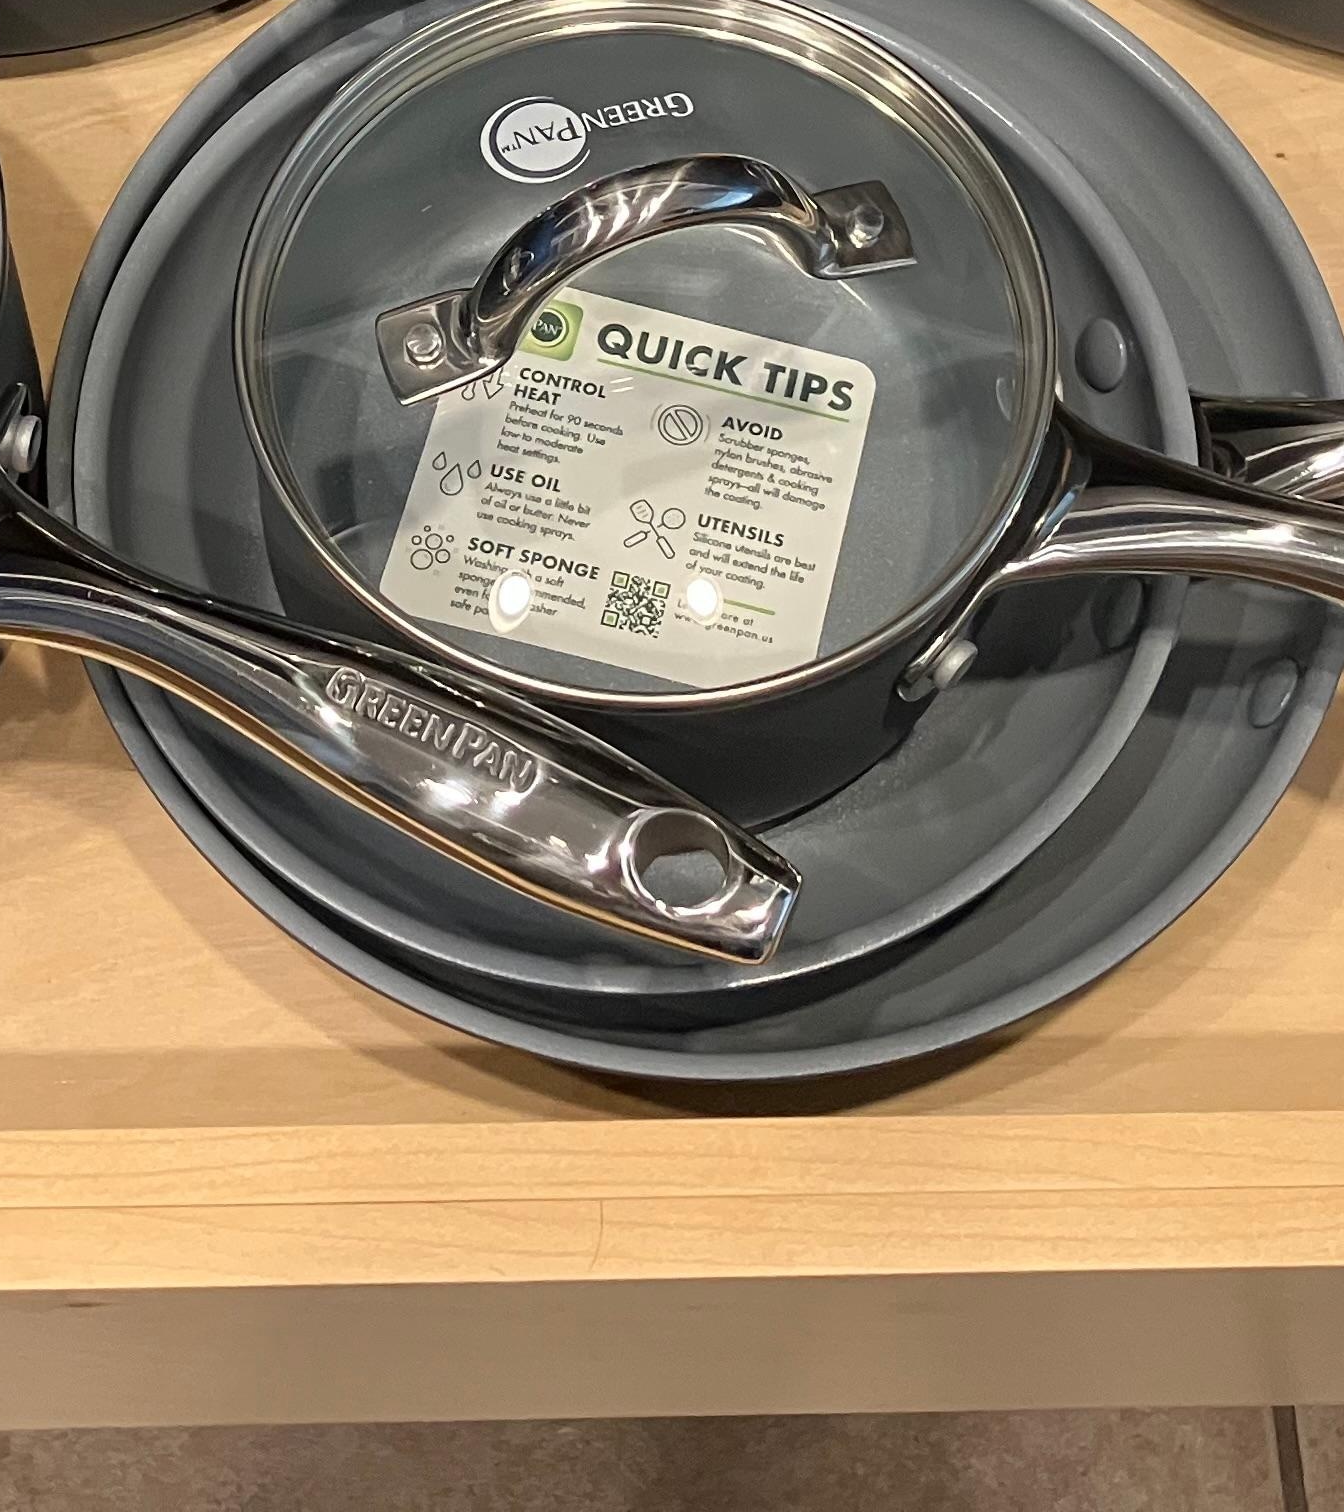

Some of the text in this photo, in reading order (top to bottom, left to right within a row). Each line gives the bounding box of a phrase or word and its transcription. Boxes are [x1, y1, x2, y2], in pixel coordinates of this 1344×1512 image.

[519, 367, 605, 398] CONTROL
[597, 323, 853, 411] QUICK TIPS
[513, 383, 561, 405] HEAT
[720, 416, 782, 440] AVOID
[490, 463, 560, 492] USE OIL
[697, 513, 784, 547] UTENSILS
[467, 537, 515, 558] SOFT
[518, 549, 600, 579] SPONGE
